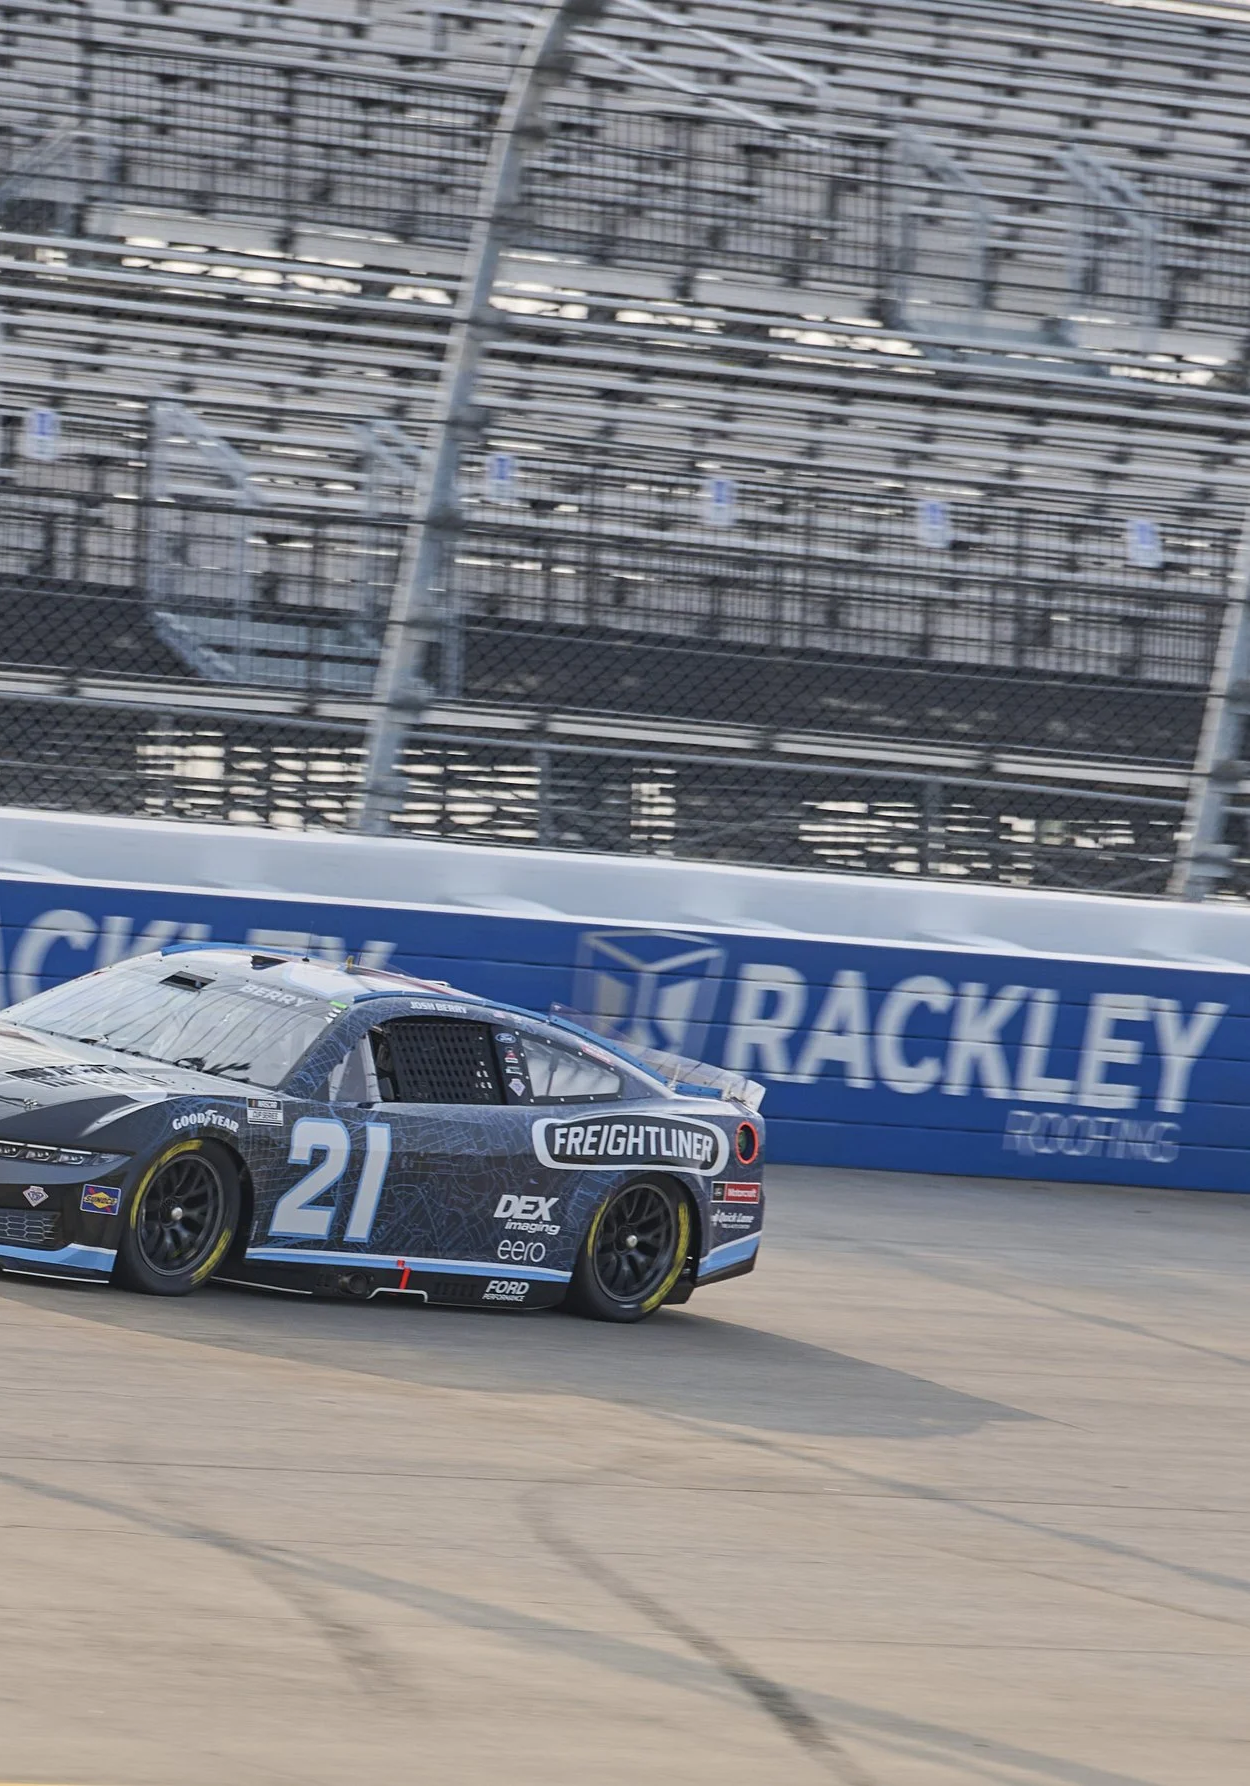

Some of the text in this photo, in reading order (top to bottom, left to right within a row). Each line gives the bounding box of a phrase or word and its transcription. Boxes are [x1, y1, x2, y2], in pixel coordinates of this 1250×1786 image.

[239, 984, 313, 1007] BERRY
[410, 1001, 468, 1014] JOSH BERRY
[723, 962, 1229, 1114] RACKLEY
[172, 1109, 240, 1133] GOODYEAR
[553, 1123, 715, 1163] FREIGHTLINER
[1001, 1109, 1182, 1164] ROOFING
[268, 1116, 392, 1244] 21
[493, 1194, 560, 1222] DEX
[504, 1219, 562, 1236] imaging
[496, 1239, 547, 1263] eero
[481, 1293, 526, 1302] PERFORMANCE
[485, 1280, 531, 1295] FORD
